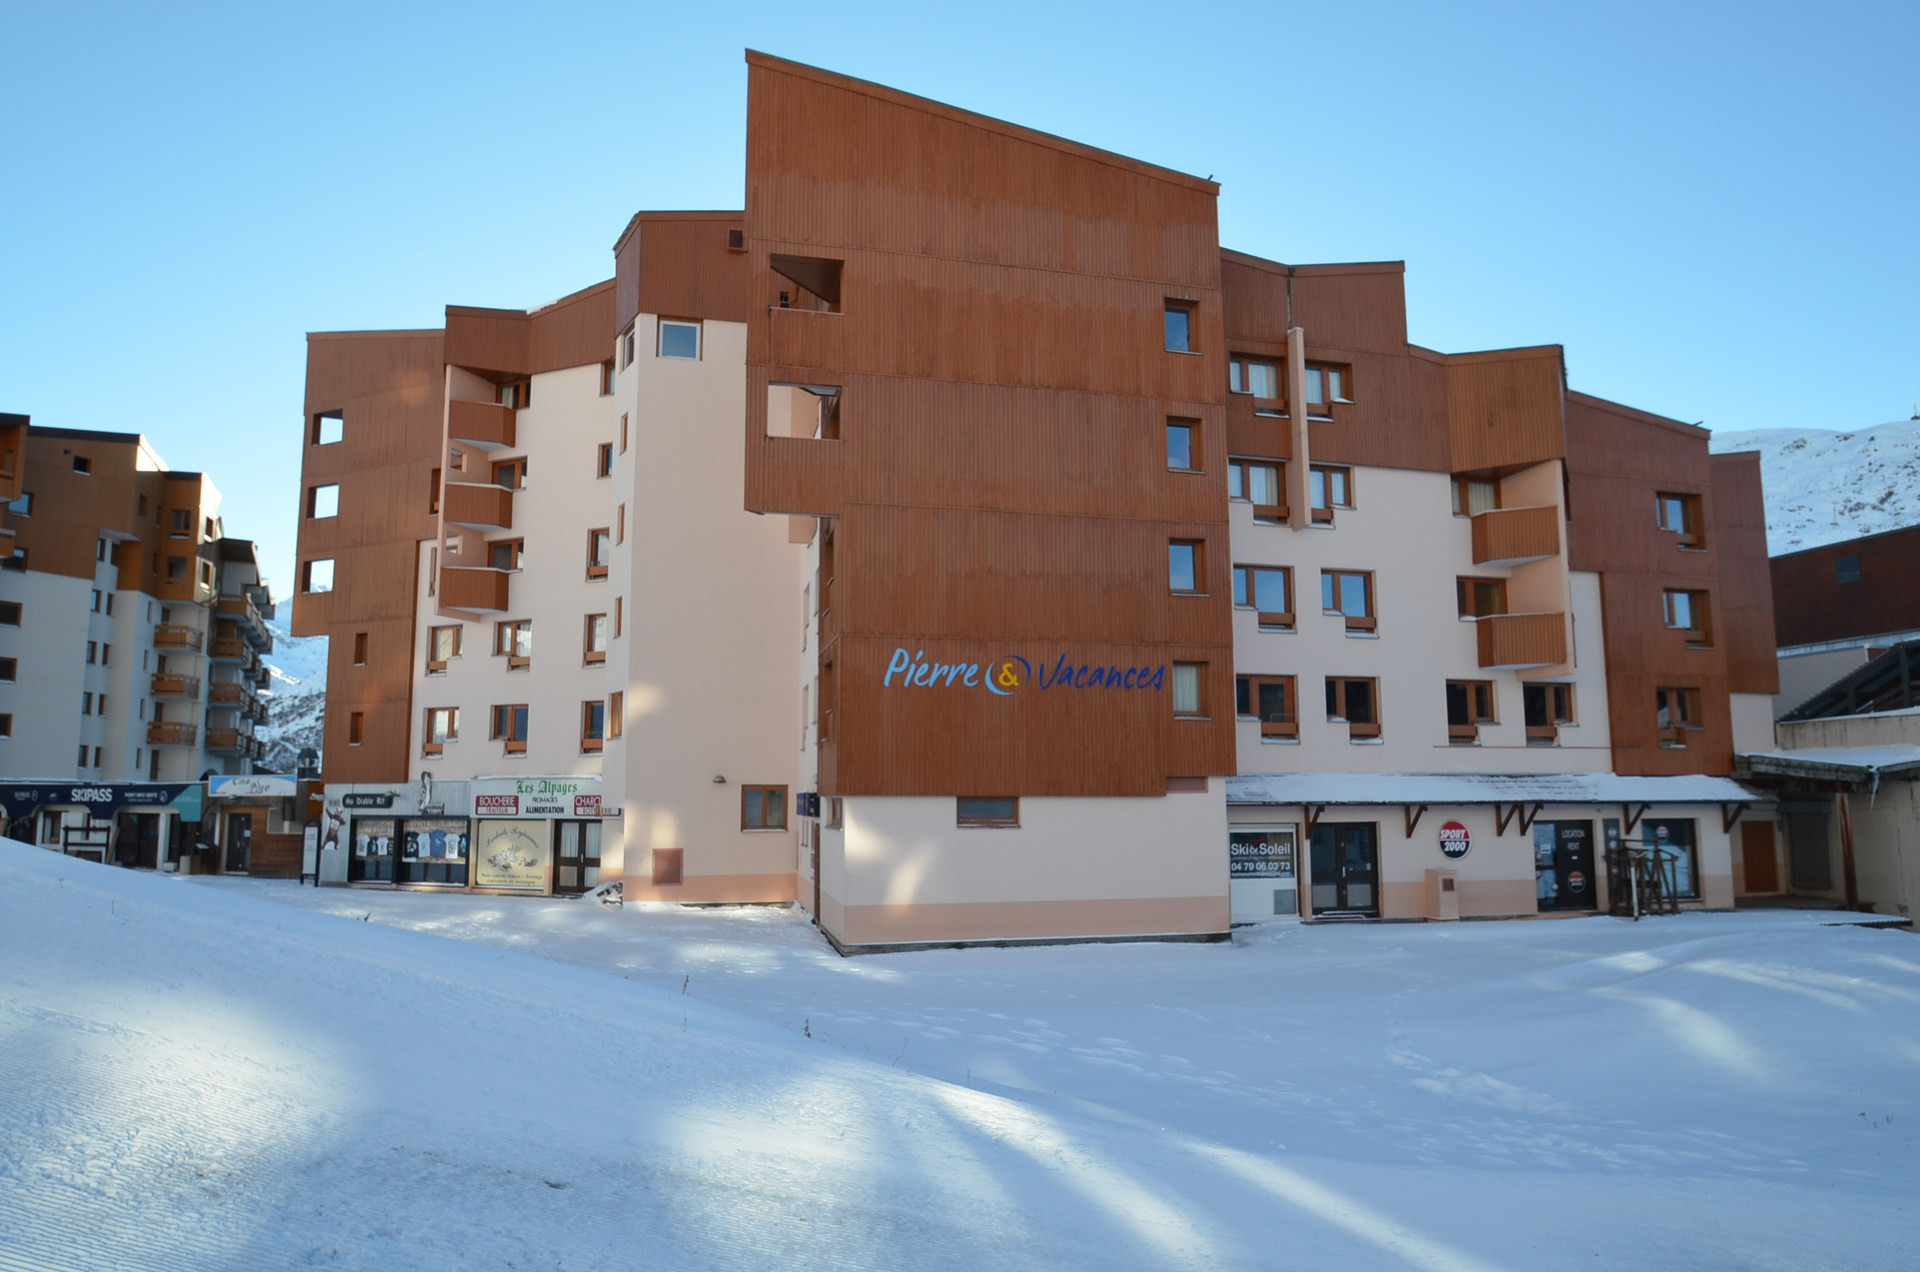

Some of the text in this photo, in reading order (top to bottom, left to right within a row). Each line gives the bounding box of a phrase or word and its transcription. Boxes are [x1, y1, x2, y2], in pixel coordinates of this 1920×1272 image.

[883, 648, 1166, 690] Pierre & Vacances
[516, 779, 578, 796] Les Alpages
[71, 788, 113, 803] SKIPASS
[345, 797, 354, 805] Au
[356, 796, 374, 805] Diable
[532, 796, 558, 804] FROMAGES
[479, 796, 515, 806] BOUCHERIE
[485, 807, 508, 815] TRAITEUR
[525, 806, 565, 815] ALIMENTATION
[1440, 829, 1466, 839] SPORT
[1562, 829, 1585, 838] LOCATION
[1231, 843, 1249, 855] Ski
[1259, 843, 1290, 855] Soleil
[1444, 841, 1466, 851] 2000
[1567, 842, 1580, 850] RENT
[1231, 862, 1242, 871] 04
[1243, 862, 1254, 871] 79
[1280, 861, 1291, 870] 73
